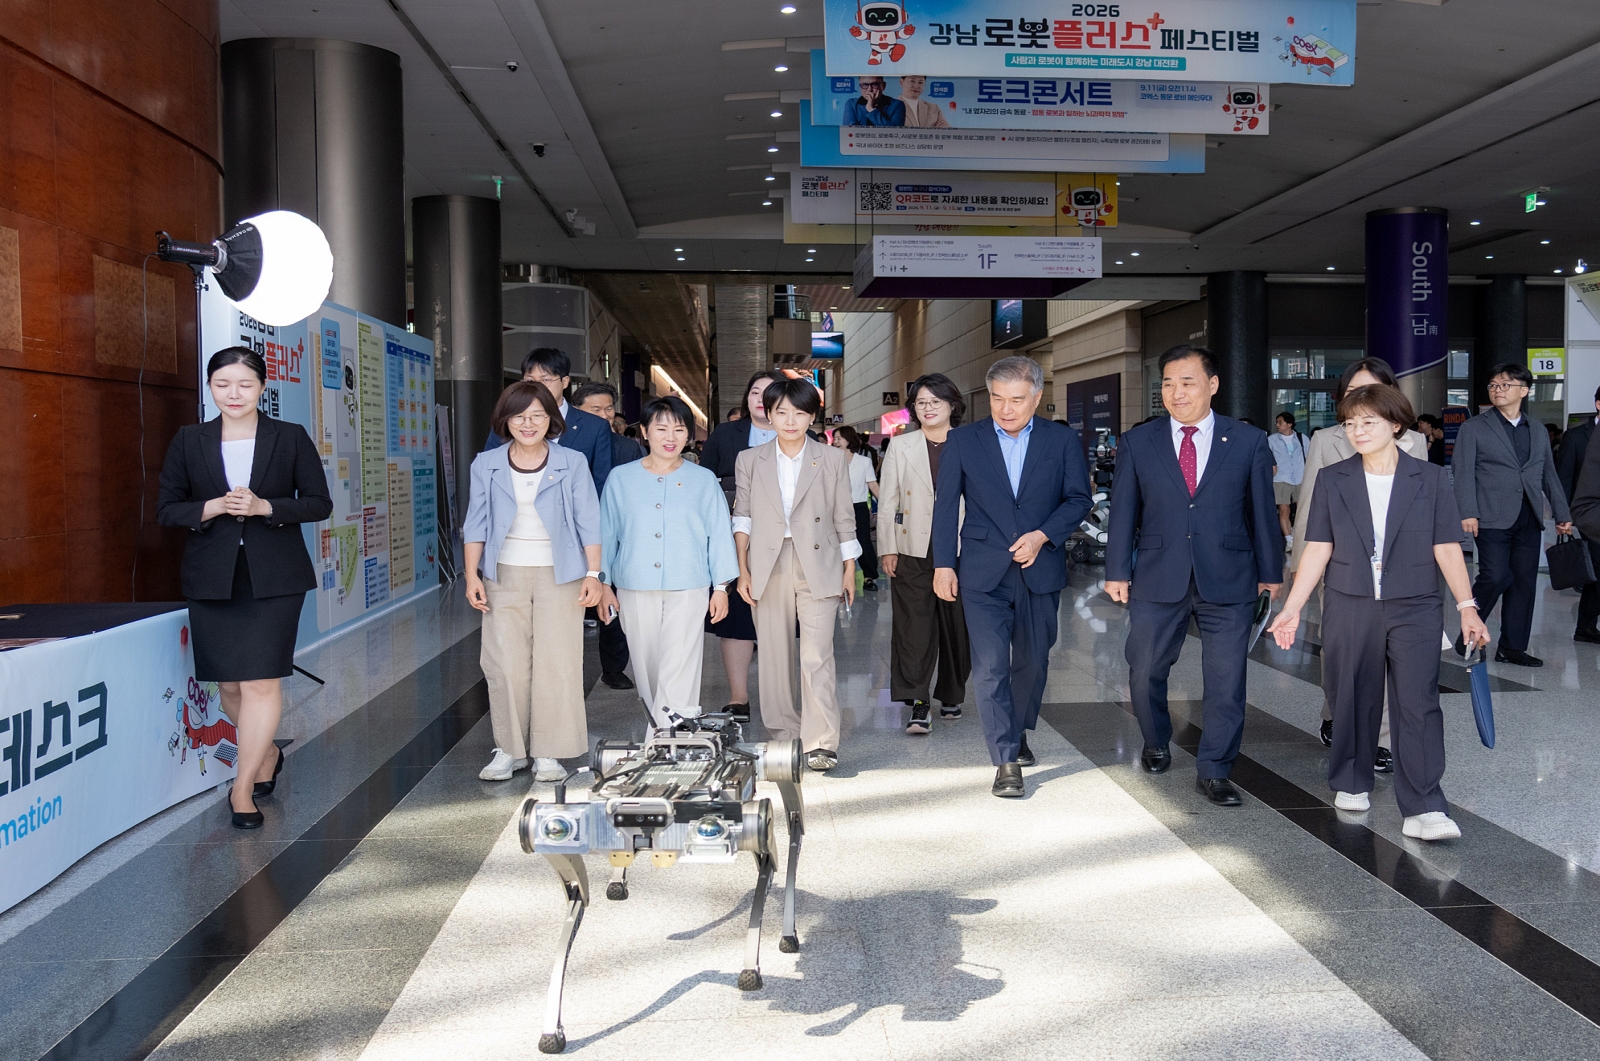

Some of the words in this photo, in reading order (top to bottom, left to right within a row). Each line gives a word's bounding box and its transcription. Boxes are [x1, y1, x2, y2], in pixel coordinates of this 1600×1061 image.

[1071, 4, 1120, 17] 2026
[928, 23, 980, 46] 강남
[1160, 28, 1260, 53] 페스티벌
[1010, 56, 1037, 66] 사람과
[1038, 57, 1063, 66] 로봇이
[1065, 57, 1099, 67] 함께하는
[1101, 57, 1133, 67] 미래도시
[1135, 58, 1152, 68] 강남
[1153, 59, 1179, 68] 대전환
[977, 79, 1113, 106] 토크콘서트
[1140, 84, 1167, 93] 9.11(금)
[1168, 85, 1196, 94] 오전11시
[1140, 93, 1158, 102] 코엑스
[1160, 94, 1173, 102] 동문
[1173, 94, 1186, 103] 로비
[1187, 95, 1213, 103] 메인무대
[999, 108, 1013, 116] 금속
[1013, 108, 1026, 116] 동료
[1045, 109, 1065, 117] 로봇과
[1066, 110, 1085, 118] 일하는
[1086, 110, 1111, 118] 뇌과학적
[802, 190, 829, 198] 페스티벌
[896, 194, 939, 205] QR코드로
[941, 195, 969, 204] 자세한
[971, 195, 998, 205] 내용을
[1000, 196, 1048, 206] 확인하세요!
[977, 253, 998, 270] 1F
[1412, 241, 1433, 301] South
[1412, 318, 1429, 336] 남
[1429, 324, 1438, 336] 南
[1539, 360, 1554, 371] 18
[884, 393, 899, 404] A2
[1443, 412, 1466, 424] RINDA
